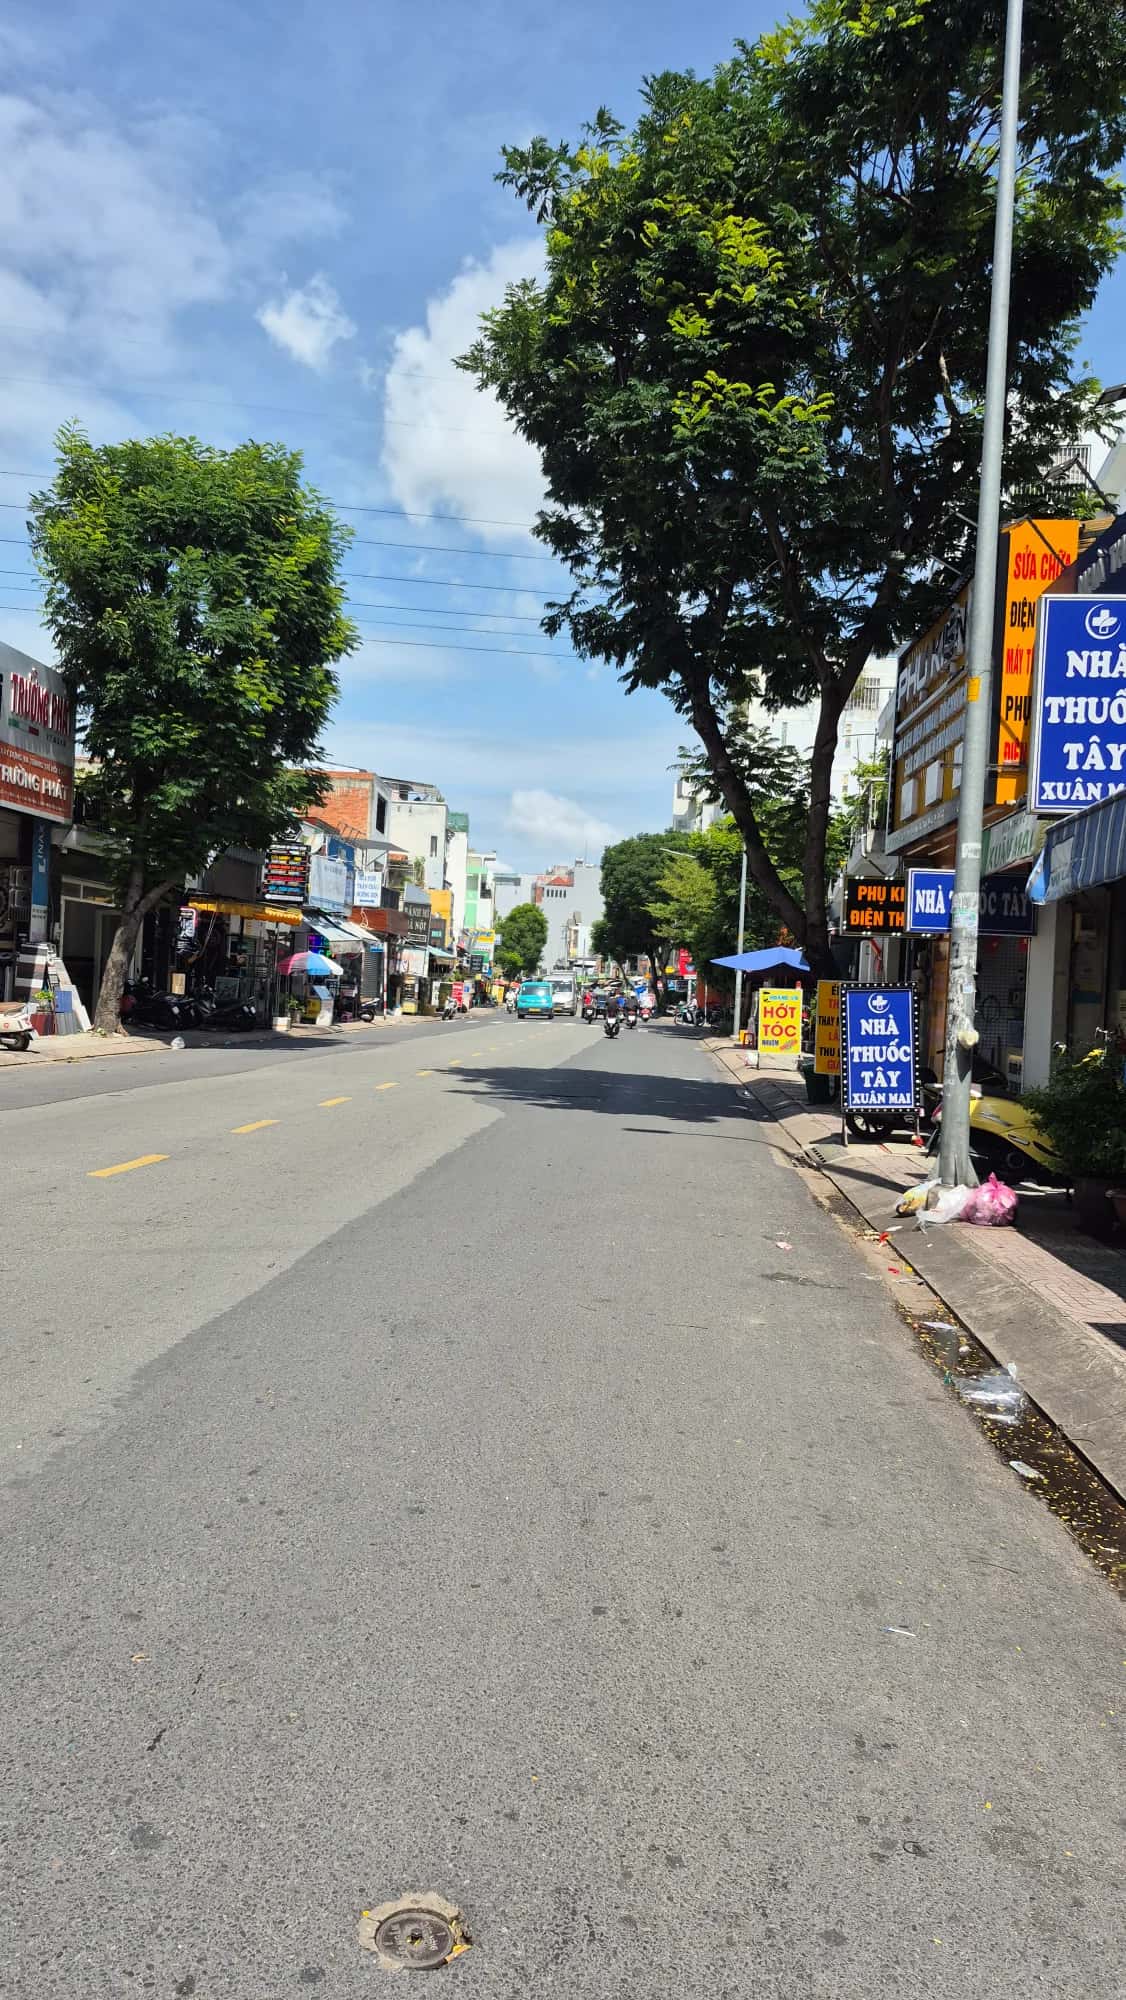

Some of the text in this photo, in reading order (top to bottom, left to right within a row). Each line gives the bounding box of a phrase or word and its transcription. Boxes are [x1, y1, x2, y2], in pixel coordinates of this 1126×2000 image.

[1010, 597, 1035, 632] ĐIỆN
[1066, 643, 1126, 678] NHÀ
[1063, 735, 1126, 770] TÂY
[1041, 777, 1102, 800] XUÂN
[858, 886, 886, 905] PHỤ
[915, 885, 945, 914] NHÀ
[850, 907, 883, 928] ĐIỆN
[763, 1003, 796, 1019] HỚT
[763, 1021, 796, 1037] TÓC
[860, 1014, 899, 1035] NHÀ
[851, 1039, 911, 1063] THUỐC
[861, 1066, 901, 1088] TÂY
[852, 1090, 911, 1104] XUÂN MAI
